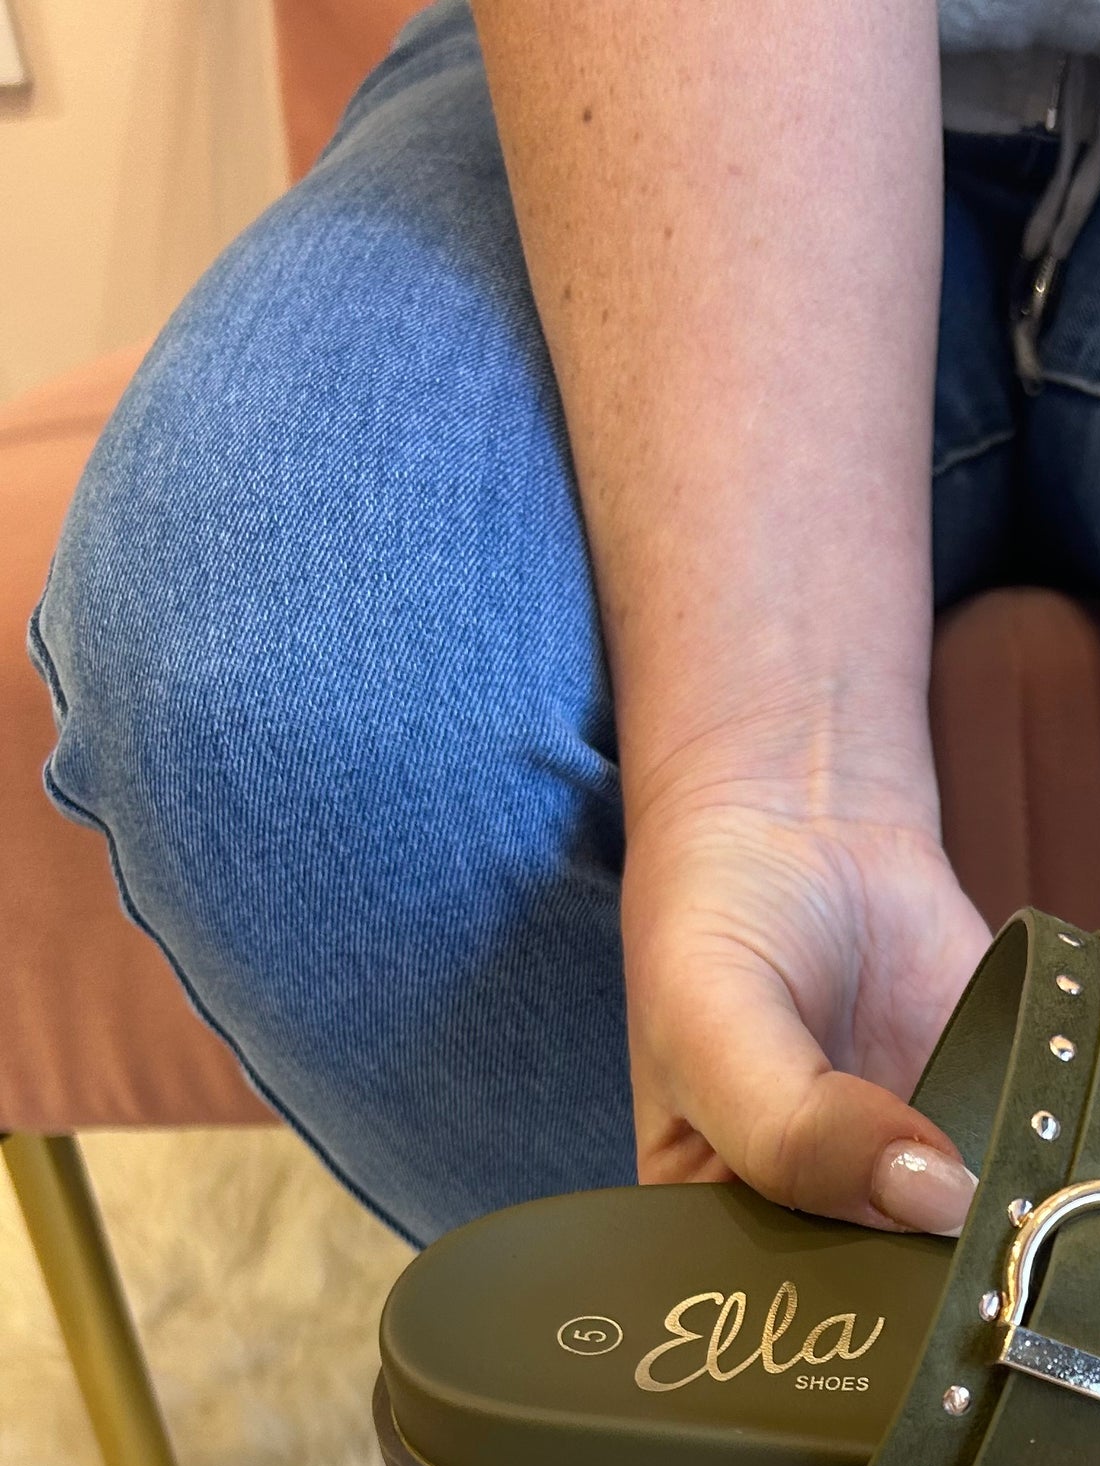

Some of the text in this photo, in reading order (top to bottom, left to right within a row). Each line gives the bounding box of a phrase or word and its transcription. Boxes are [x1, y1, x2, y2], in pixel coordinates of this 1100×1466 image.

[573, 1329, 606, 1343] 5
[634, 1280, 885, 1392] Ella
[794, 1375, 870, 1392] SHOES
